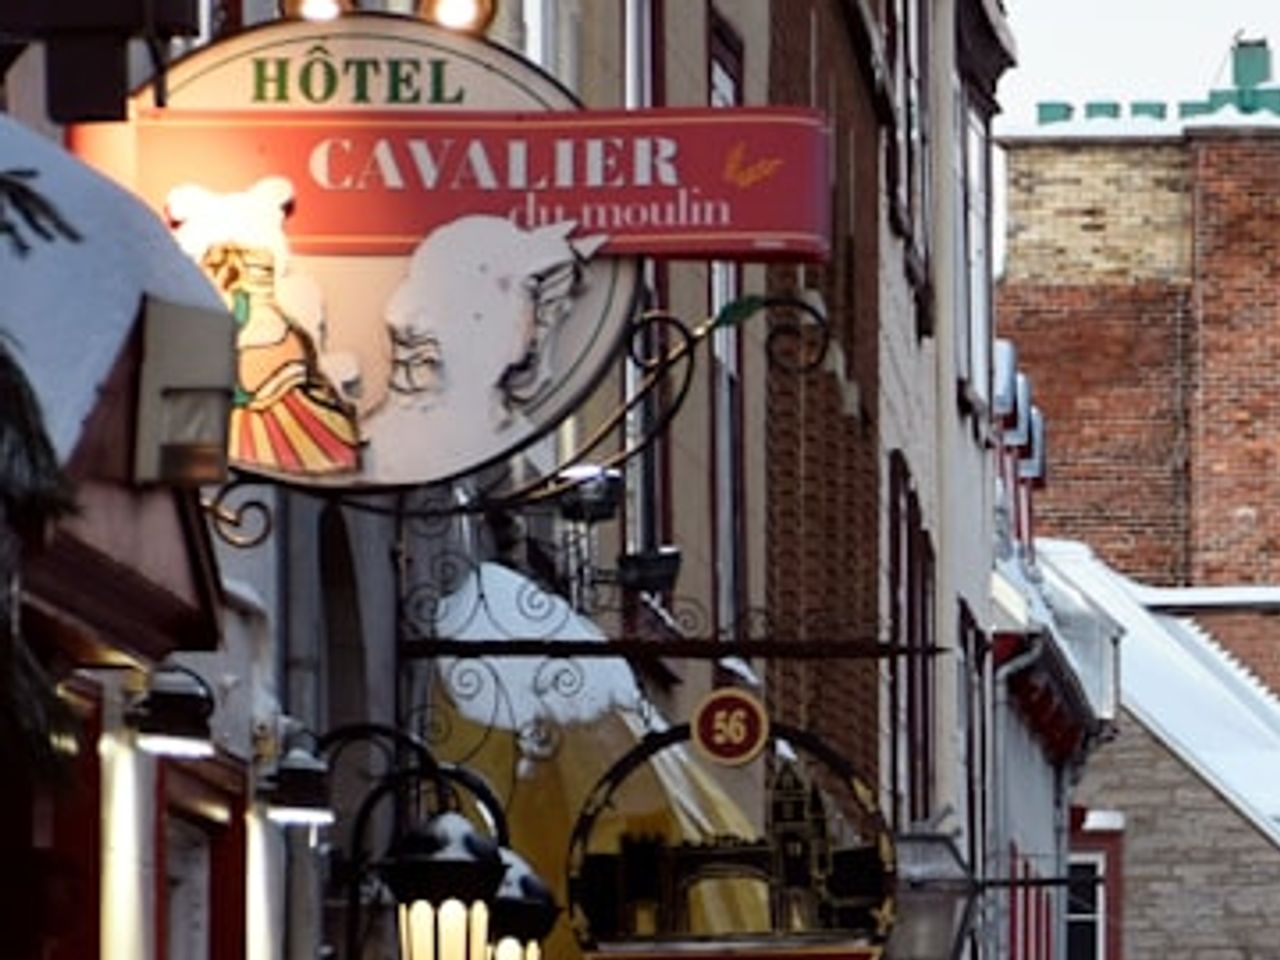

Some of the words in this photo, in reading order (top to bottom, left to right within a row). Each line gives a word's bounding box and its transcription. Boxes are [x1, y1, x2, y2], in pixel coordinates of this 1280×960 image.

[251, 46, 466, 105] HÔTEL
[309, 137, 681, 190] CAVALIER
[582, 187, 731, 229] moulin
[713, 708, 747, 744] 56
